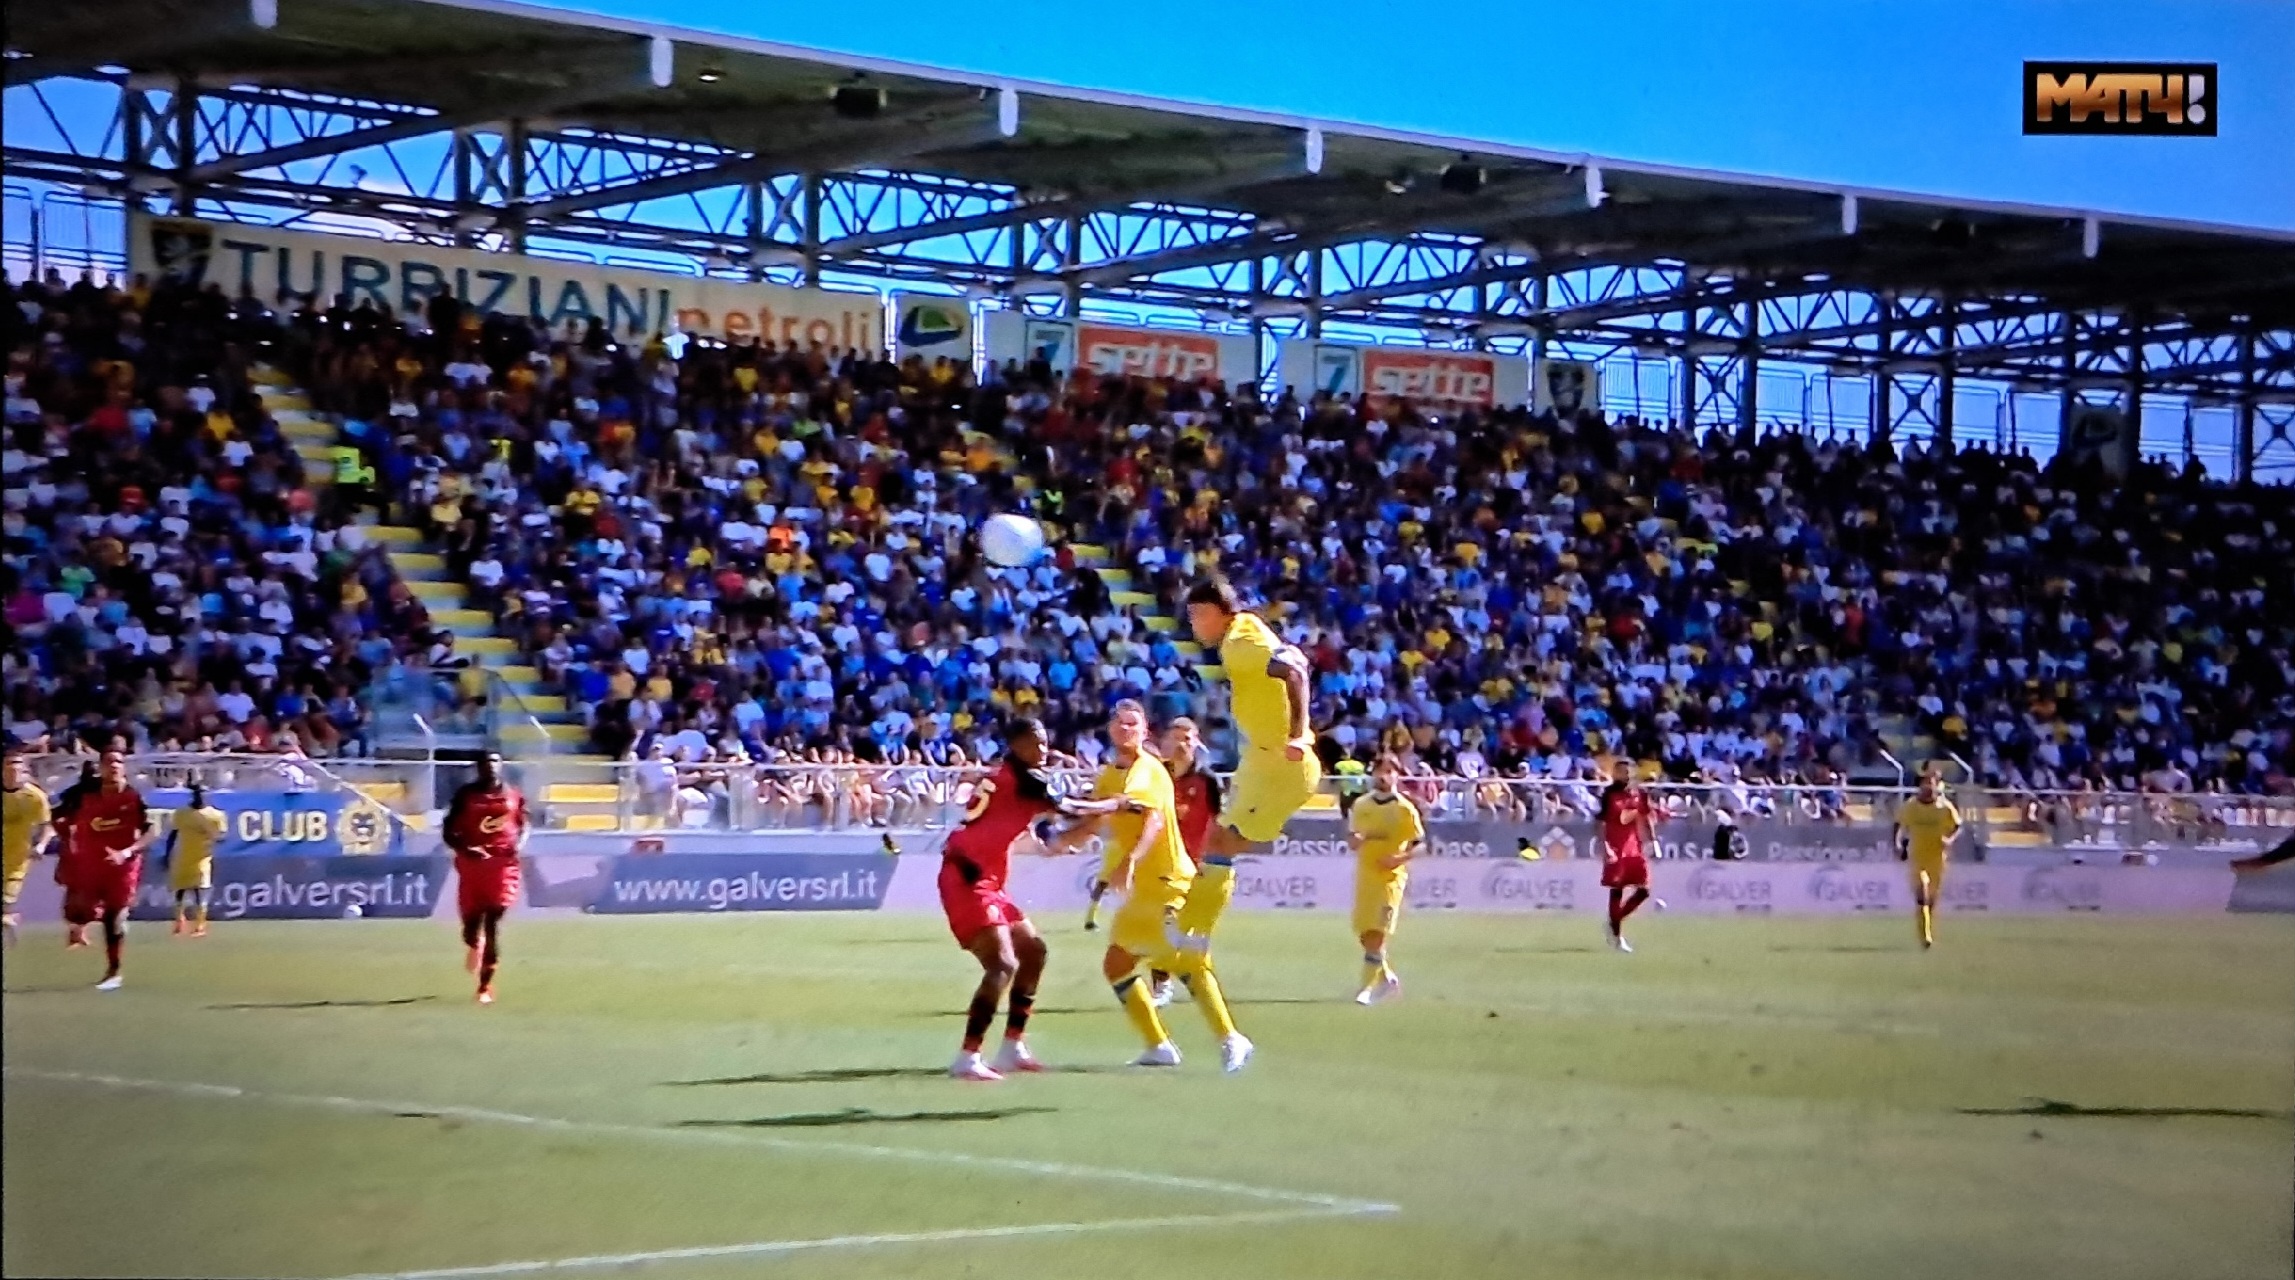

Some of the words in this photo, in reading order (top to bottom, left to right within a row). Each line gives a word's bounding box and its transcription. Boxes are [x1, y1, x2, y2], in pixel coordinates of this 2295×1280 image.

[1321, 355, 1352, 394] 7
[237, 810, 328, 842] CLUB
[1273, 833, 1349, 857] Passio
[140, 872, 430, 918] w.galversrl.it
[613, 869, 878, 910] www.galversrl.it
